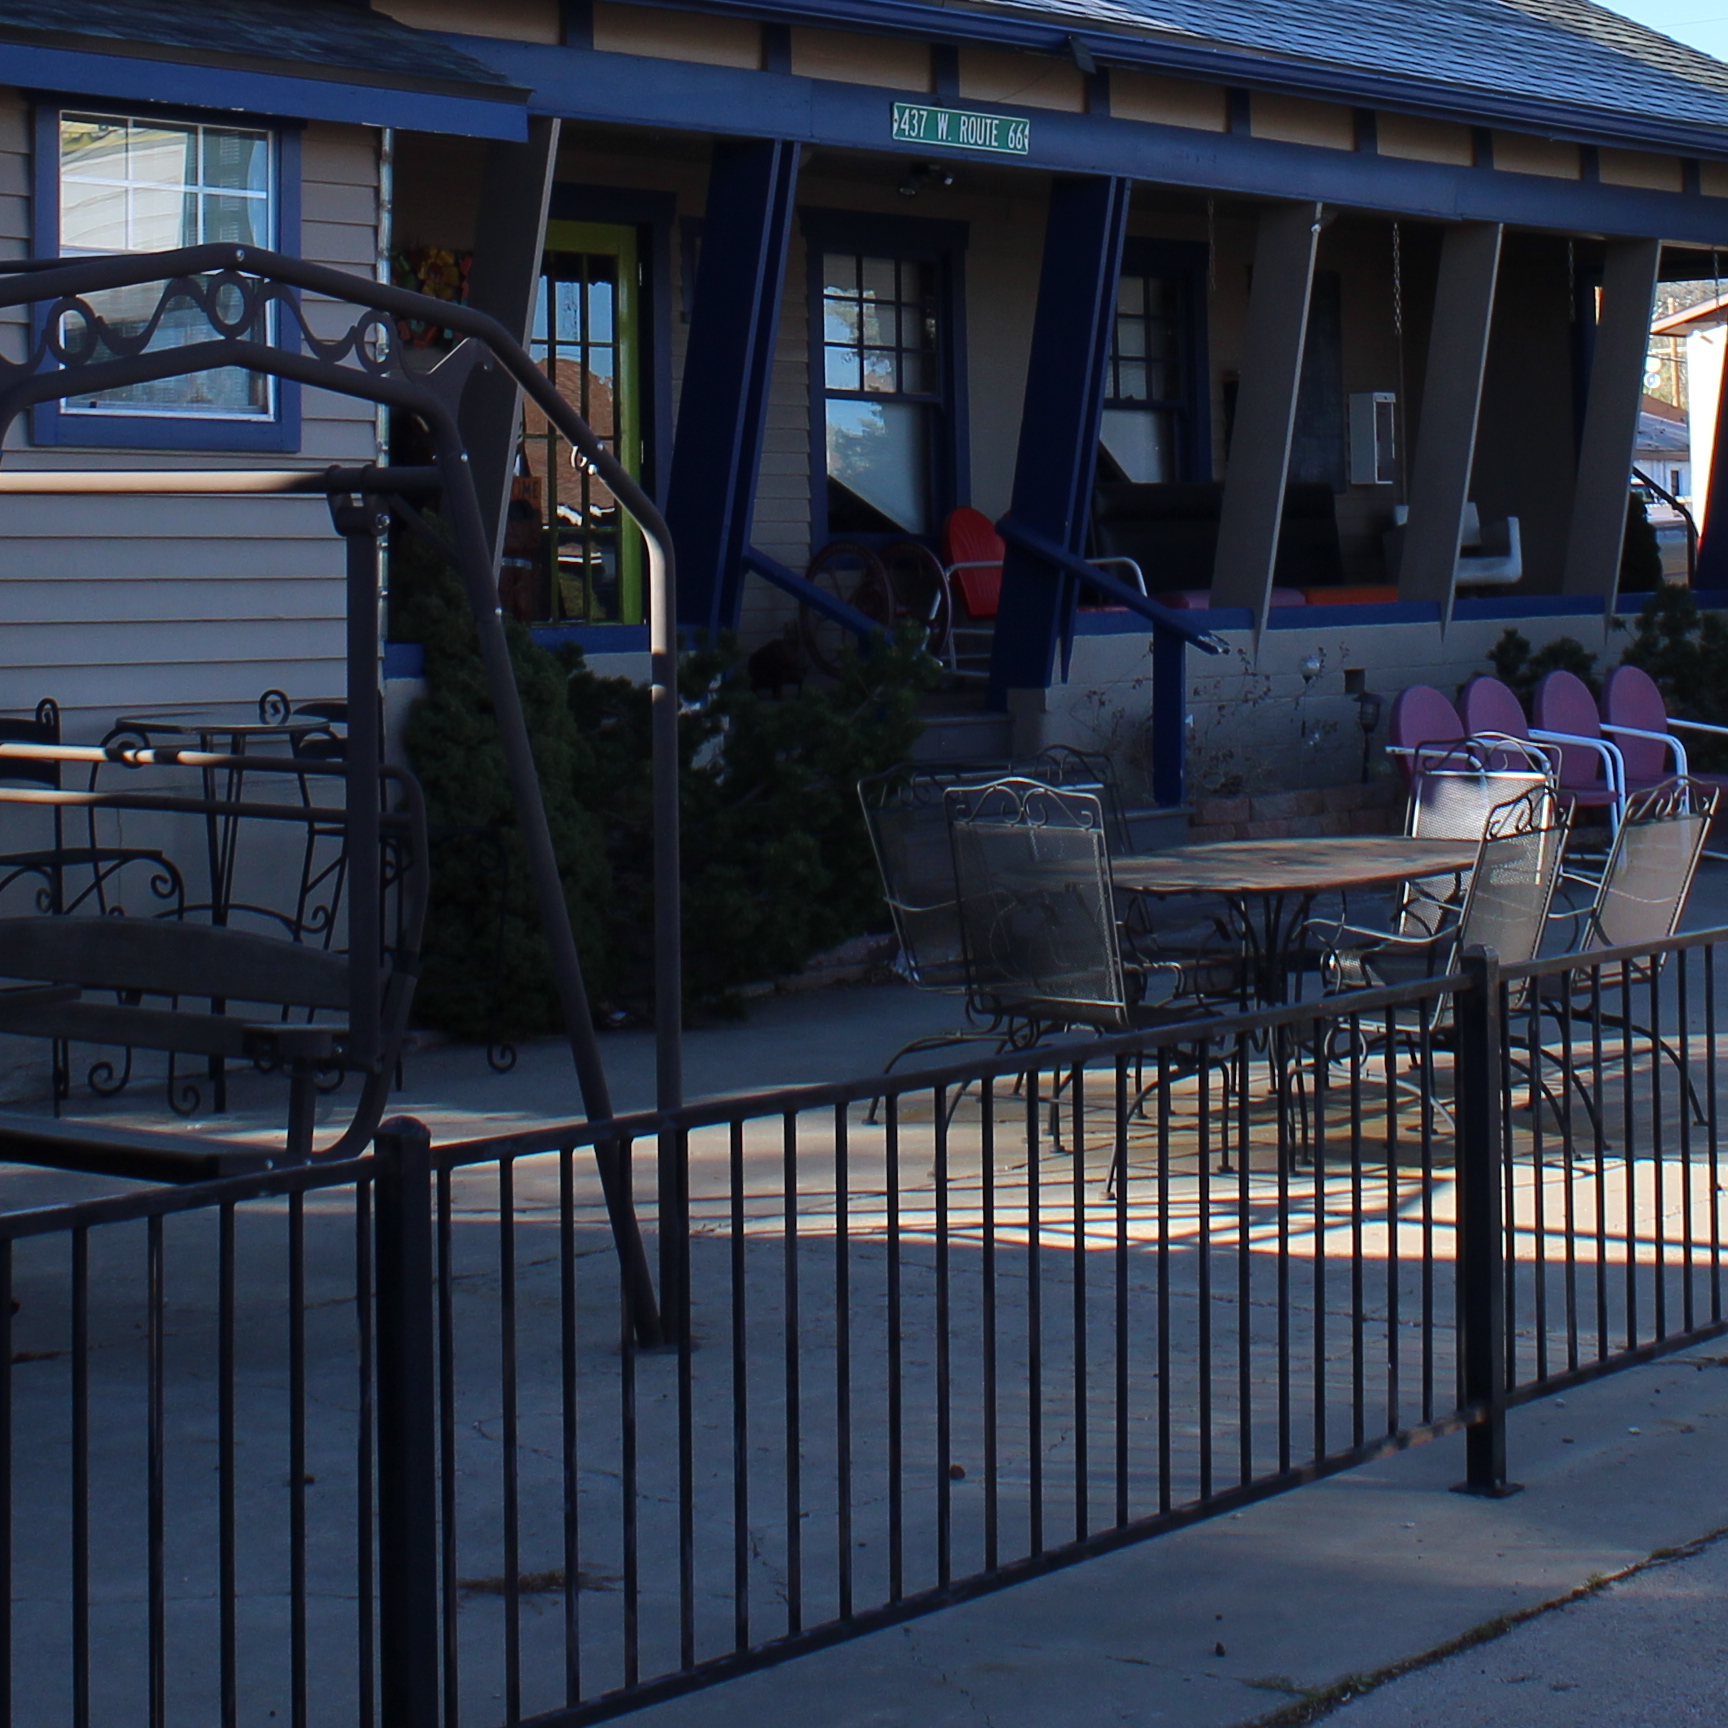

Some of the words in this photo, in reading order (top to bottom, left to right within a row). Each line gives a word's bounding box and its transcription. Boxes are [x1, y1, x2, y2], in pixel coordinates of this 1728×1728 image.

[900, 107, 928, 138] 437
[937, 112, 952, 141] W.
[959, 115, 1000, 147] ROUTE
[1007, 123, 1023, 150] 66
